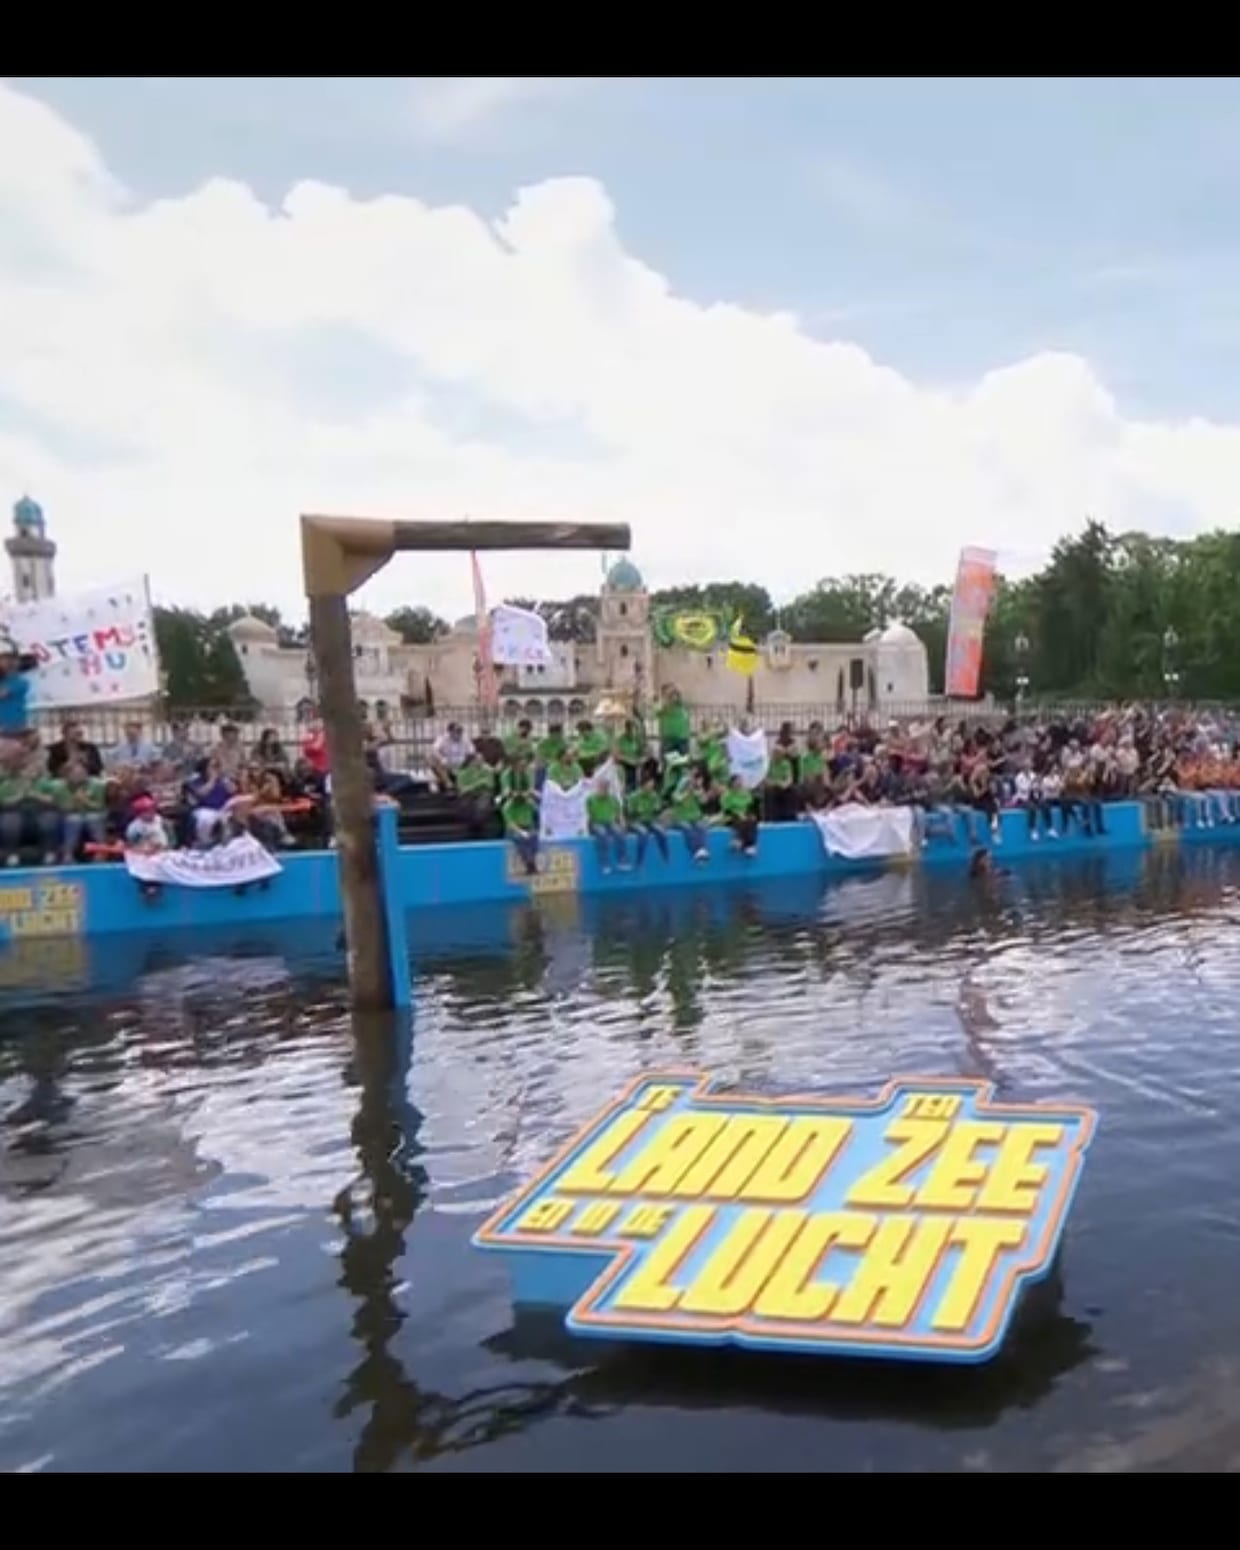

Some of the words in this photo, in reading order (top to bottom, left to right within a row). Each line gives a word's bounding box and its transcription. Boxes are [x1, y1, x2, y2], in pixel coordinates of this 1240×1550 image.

[554, 1109, 854, 1205] LAND
[844, 1116, 1065, 1214] ZEE
[612, 1203, 1029, 1331] LUCHT
